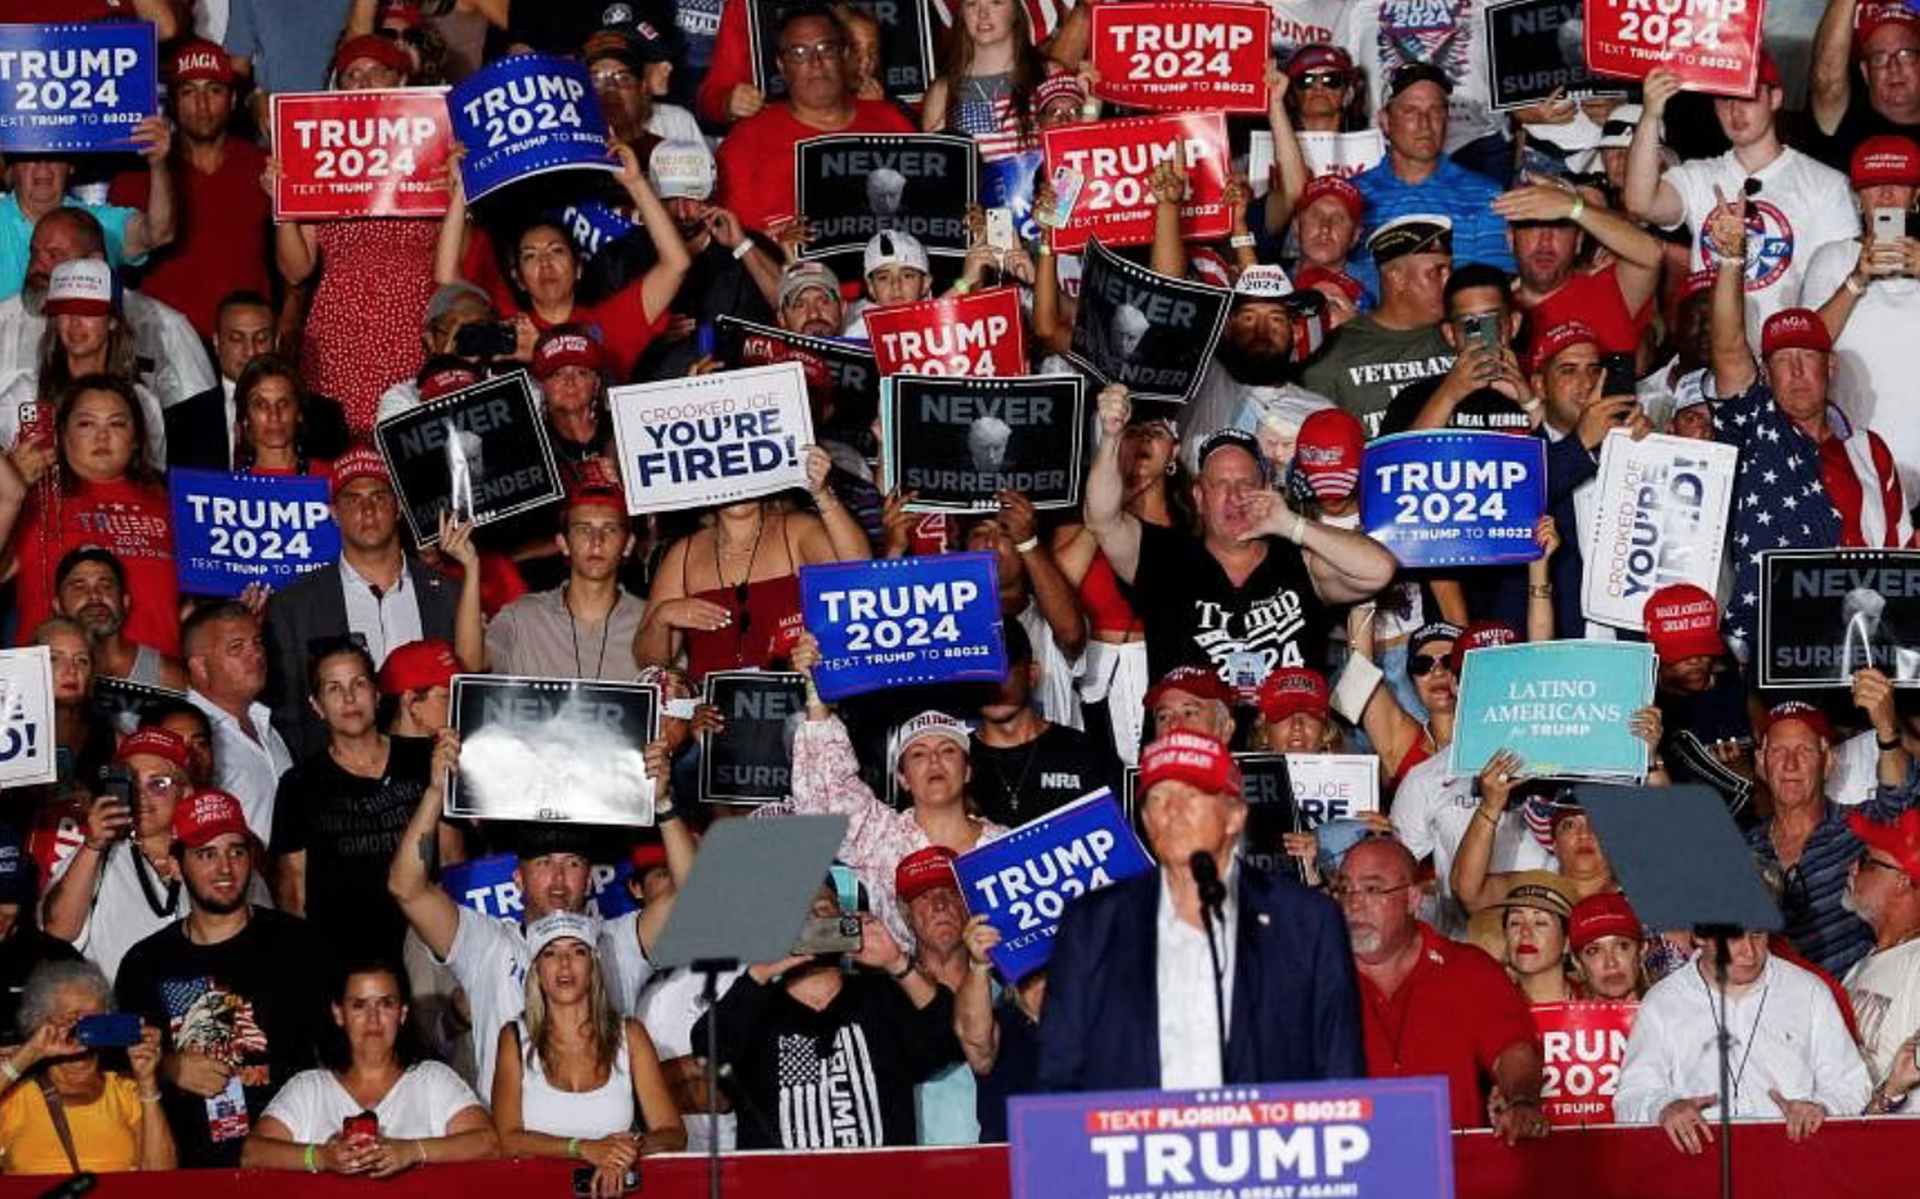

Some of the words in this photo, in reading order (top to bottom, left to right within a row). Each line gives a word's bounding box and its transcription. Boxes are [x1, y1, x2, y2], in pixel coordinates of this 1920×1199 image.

[1510, 2, 1583, 38] NEV
[1618, 11, 1720, 49] 2024
[1109, 23, 1252, 51] TRUMP
[0, 48, 138, 80] TRUMP
[177, 52, 219, 73] MAGA
[1128, 51, 1232, 80] 2024
[1597, 41, 1626, 55] TEXT
[1629, 47, 1673, 61] TRUMP
[1677, 53, 1695, 65] TO
[15, 79, 119, 110] 2024
[464, 75, 584, 125] TRUMP
[1105, 82, 1138, 92] TEXT
[1142, 83, 1188, 92] TRUMP
[1193, 82, 1210, 92] TO
[0, 116, 26, 128] EXT
[31, 114, 77, 126] TRUMP
[82, 115, 98, 126] TO
[293, 118, 437, 149] TRUMP
[486, 104, 582, 148] 2024
[315, 148, 417, 180] 2024
[474, 152, 501, 172] TEXT
[503, 136, 548, 158] TRUMP
[551, 132, 570, 143] TO
[821, 150, 948, 178] NEVER
[1064, 139, 1212, 178] TRUMP
[291, 184, 323, 196] TEXT
[329, 182, 373, 194] TRUMP
[1104, 209, 1152, 224] TRUMP
[1244, 280, 1280, 292] 2024
[743, 338, 774, 358] AGA
[881, 315, 1009, 362] TRUMP
[640, 399, 736, 425] CROOKED
[744, 391, 781, 411] JOE
[919, 394, 1055, 425] NEVER
[1457, 412, 1486, 427] REAL
[1489, 413, 1530, 428] VERDIC
[400, 397, 514, 459] NEVER
[644, 408, 783, 449] YOU'RE
[637, 434, 799, 488] FIRED!
[906, 468, 1066, 493] SURRENDER
[1376, 460, 1528, 494] TRUMP
[186, 495, 330, 529] TRUMP
[1394, 492, 1507, 525] 2024
[78, 512, 169, 539] TRUMP
[1412, 528, 1461, 541] TRUMP
[1465, 528, 1485, 539] TO
[209, 528, 312, 560] 2024
[191, 557, 221, 571] TEXT
[224, 561, 268, 575] TRUMP
[272, 563, 291, 575] TO
[295, 562, 331, 574] 880
[1792, 569, 1920, 599] NEVER
[819, 580, 979, 623] TRUMP
[845, 613, 961, 651] 2024
[824, 656, 860, 672] TEXT
[864, 651, 916, 665] TRUMP
[921, 648, 940, 660] TO
[943, 645, 989, 659] 88022
[1211, 640, 1305, 682] 224
[1509, 680, 1596, 700] LATINO
[484, 695, 626, 732] NEVER
[1484, 703, 1621, 724] AMERICANS
[1530, 724, 1590, 737] TRUMP
[1040, 771, 1082, 790] NRA
[1315, 781, 1351, 798] JOE
[975, 828, 1115, 909] TRUMP
[1006, 932, 1038, 952] TEXT
[1540, 1064, 1621, 1098] 202
[1099, 1110, 1153, 1131] TEXT
[1157, 1106, 1254, 1129] FLORIDA
[1258, 1104, 1289, 1123] TO
[1294, 1100, 1361, 1121] 88022
[1553, 1102, 1606, 1114] TRUMP
[1090, 1124, 1371, 1188] TRUMP
